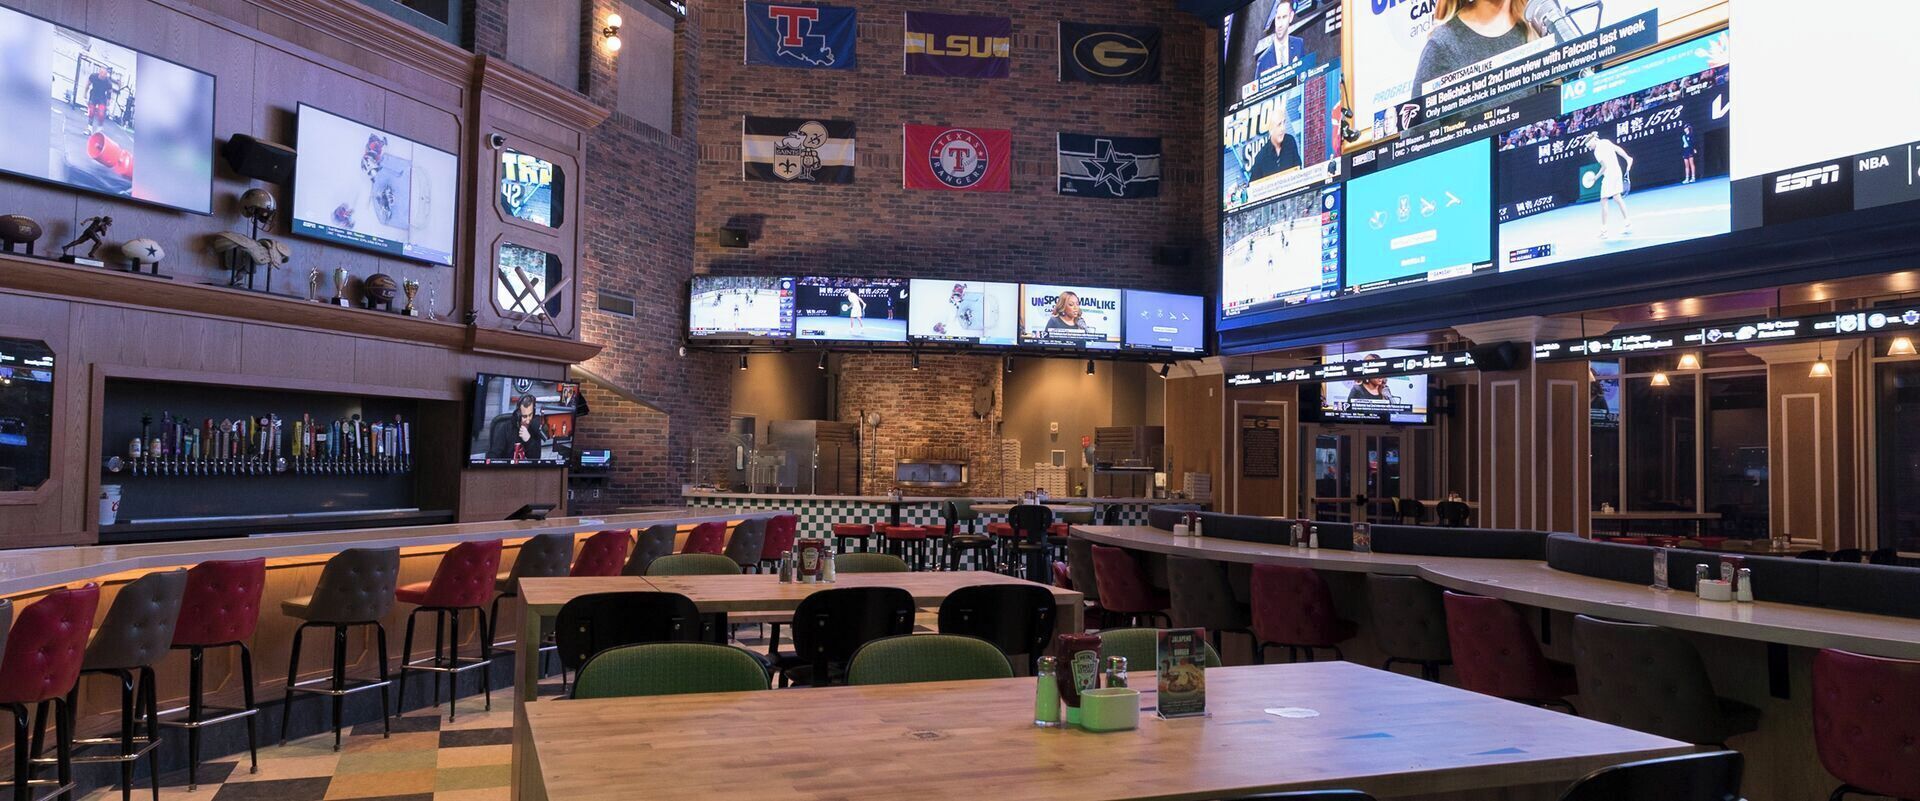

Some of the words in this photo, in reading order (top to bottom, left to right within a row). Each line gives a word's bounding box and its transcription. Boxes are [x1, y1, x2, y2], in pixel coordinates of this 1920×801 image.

[770, 6, 817, 46] T
[925, 33, 995, 57] LSU
[1093, 41, 1147, 68] G
[1425, 94, 1437, 109] Bill
[1438, 83, 1471, 104] Belichick
[1472, 76, 1487, 92] had
[1488, 70, 1503, 86] 2nd
[1505, 58, 1541, 79] interview
[1543, 51, 1561, 66] with
[1563, 40, 1598, 61] Falcons
[1600, 30, 1617, 47] last
[1619, 19, 1646, 39] week
[1426, 105, 1441, 118] Only
[1459, 91, 1489, 107] Belichick
[1498, 80, 1521, 93] known
[1532, 68, 1550, 80] have
[1551, 51, 1597, 74] interviewed
[1598, 45, 1616, 59] with
[1444, 121, 1466, 133] Thunder
[938, 133, 979, 149] TEXAS
[949, 147, 970, 172] T
[933, 161, 984, 185] RANGERS
[1775, 164, 1840, 194] ESPN
[1859, 155, 1889, 171] NBA
